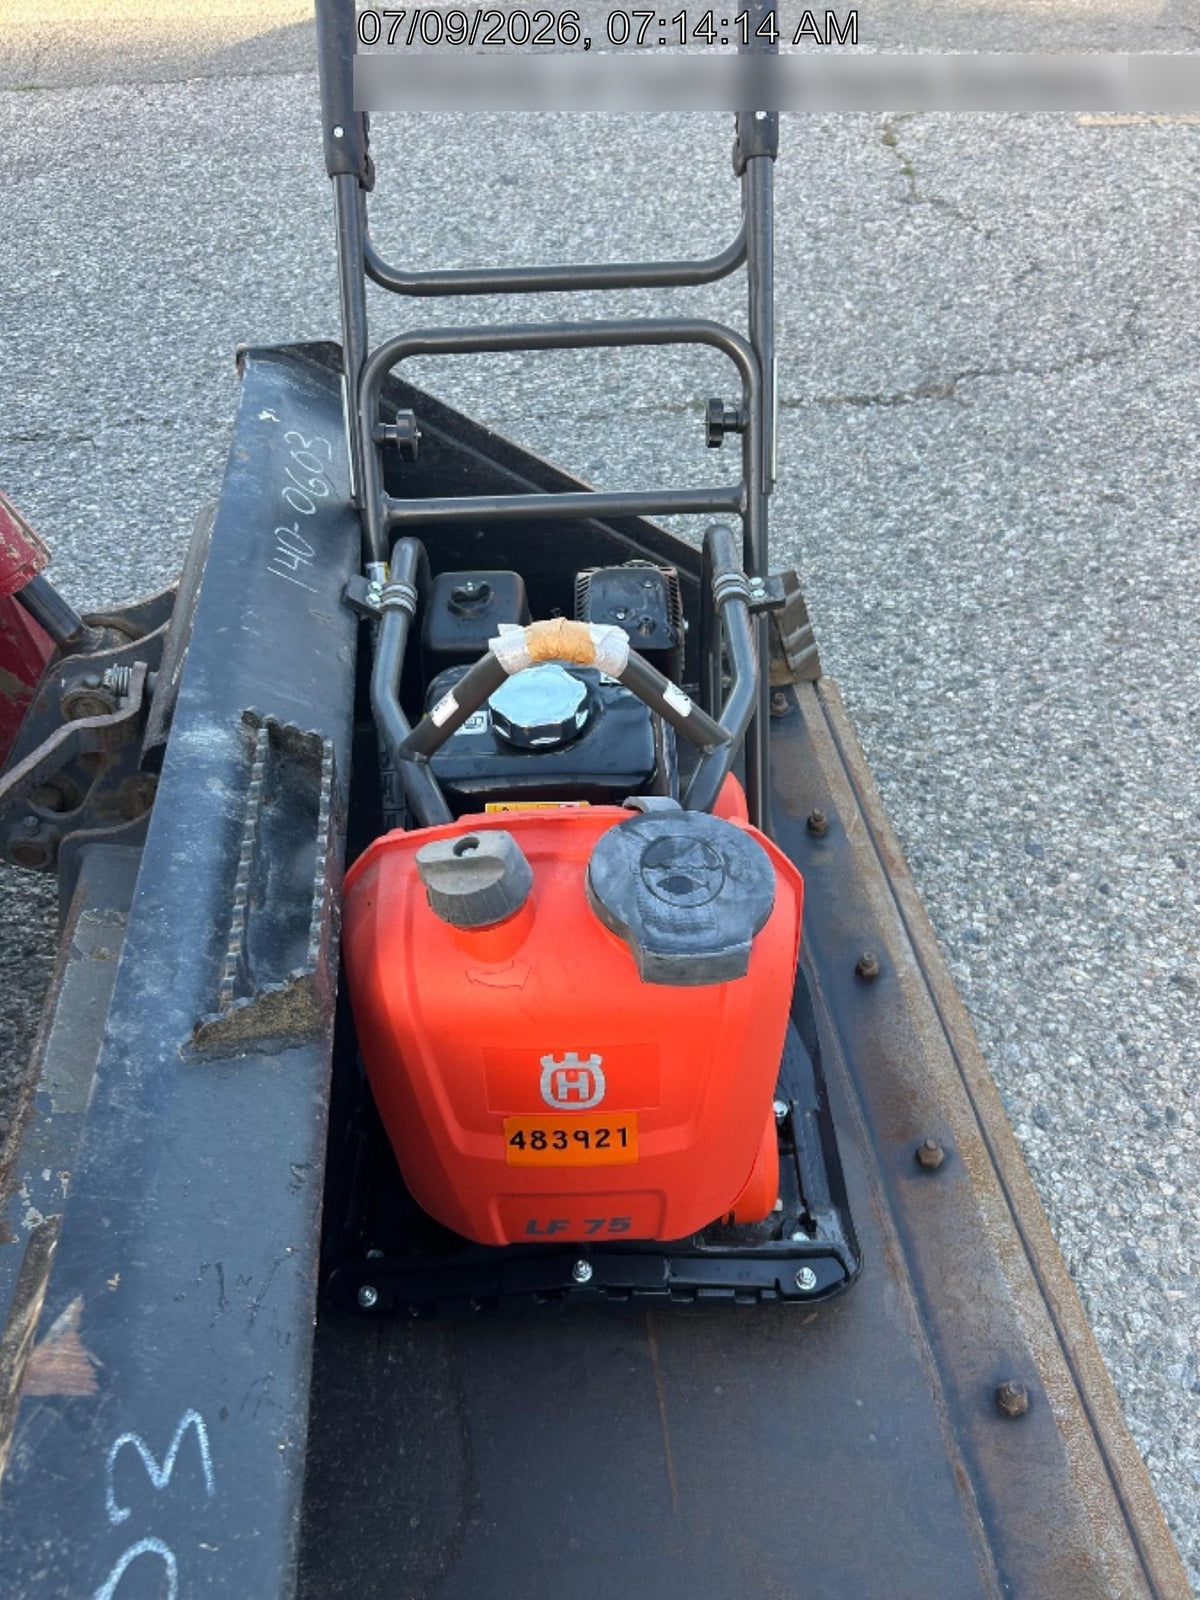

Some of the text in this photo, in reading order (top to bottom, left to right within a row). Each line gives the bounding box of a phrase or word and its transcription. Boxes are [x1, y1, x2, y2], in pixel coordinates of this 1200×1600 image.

[509, 1127, 628, 1151] 483921
[526, 1216, 632, 1236] LF 75
